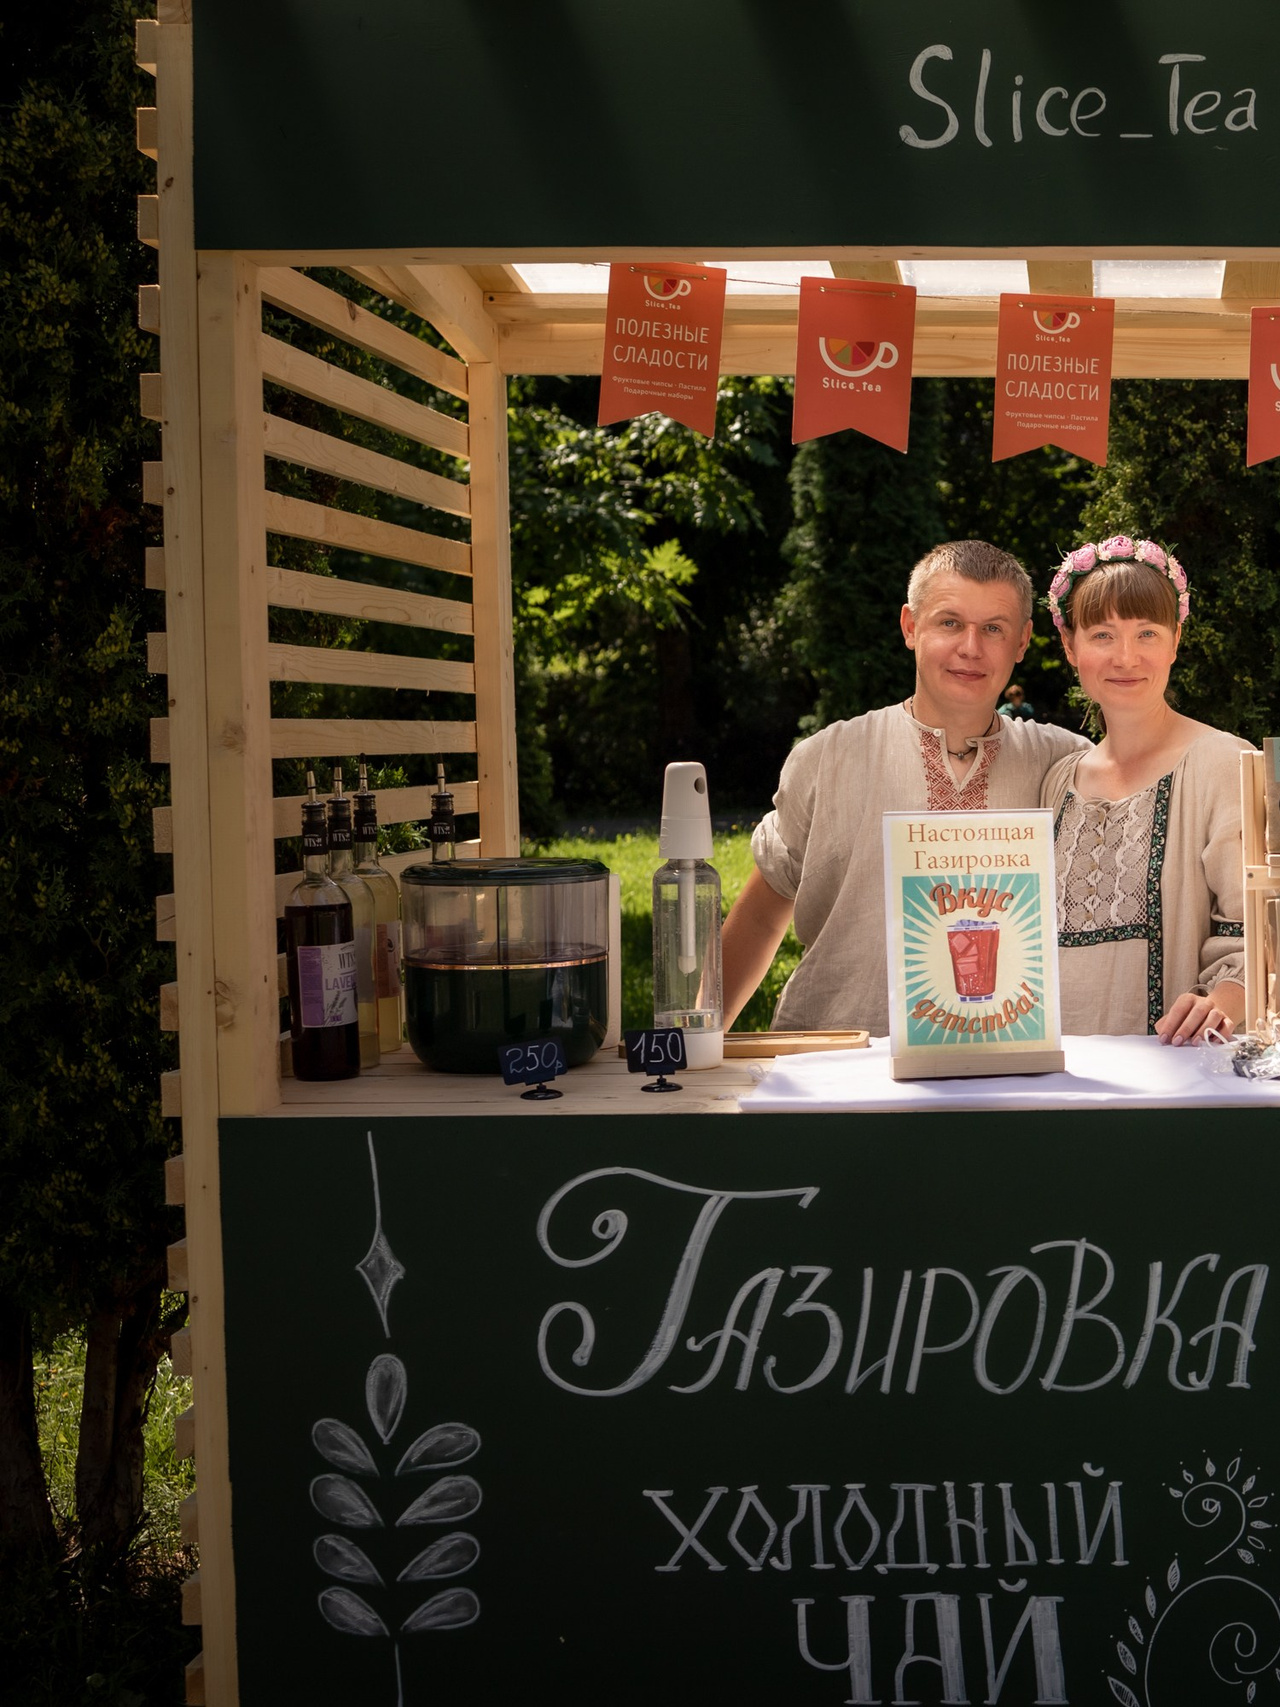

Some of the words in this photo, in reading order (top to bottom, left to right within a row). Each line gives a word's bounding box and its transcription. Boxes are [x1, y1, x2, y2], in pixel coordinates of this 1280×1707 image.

[899, 44, 1258, 149] Slice_Tea
[616, 318, 710, 344] ПОЛЕЗНЫЕ
[613, 345, 708, 371] СЛАДОСТИ
[1007, 354, 1100, 374] ПОЛЕЗНЫЕ
[612, 376, 650, 386] Фруктовые
[678, 383, 706, 392] Пастила
[623, 387, 667, 397] Подарочные
[668, 392, 694, 400] наборы
[822, 377, 882, 392] Slice_Tea
[1005, 380, 1099, 401] СЛАДОСТИ
[1005, 411, 1042, 419] Фруктовые
[1071, 414, 1099, 422] Пастила
[1016, 421, 1059, 430] Подарочные
[907, 823, 1035, 843] Настоящая
[914, 851, 1031, 874] Газировка
[929, 882, 1014, 918] Вкус
[911, 981, 1040, 1034] детства!
[632, 1032, 682, 1064] 150
[642, 1462, 1130, 1575] ХОЛОДНЫЙ
[791, 1577, 1070, 1706] ЧАЙ
